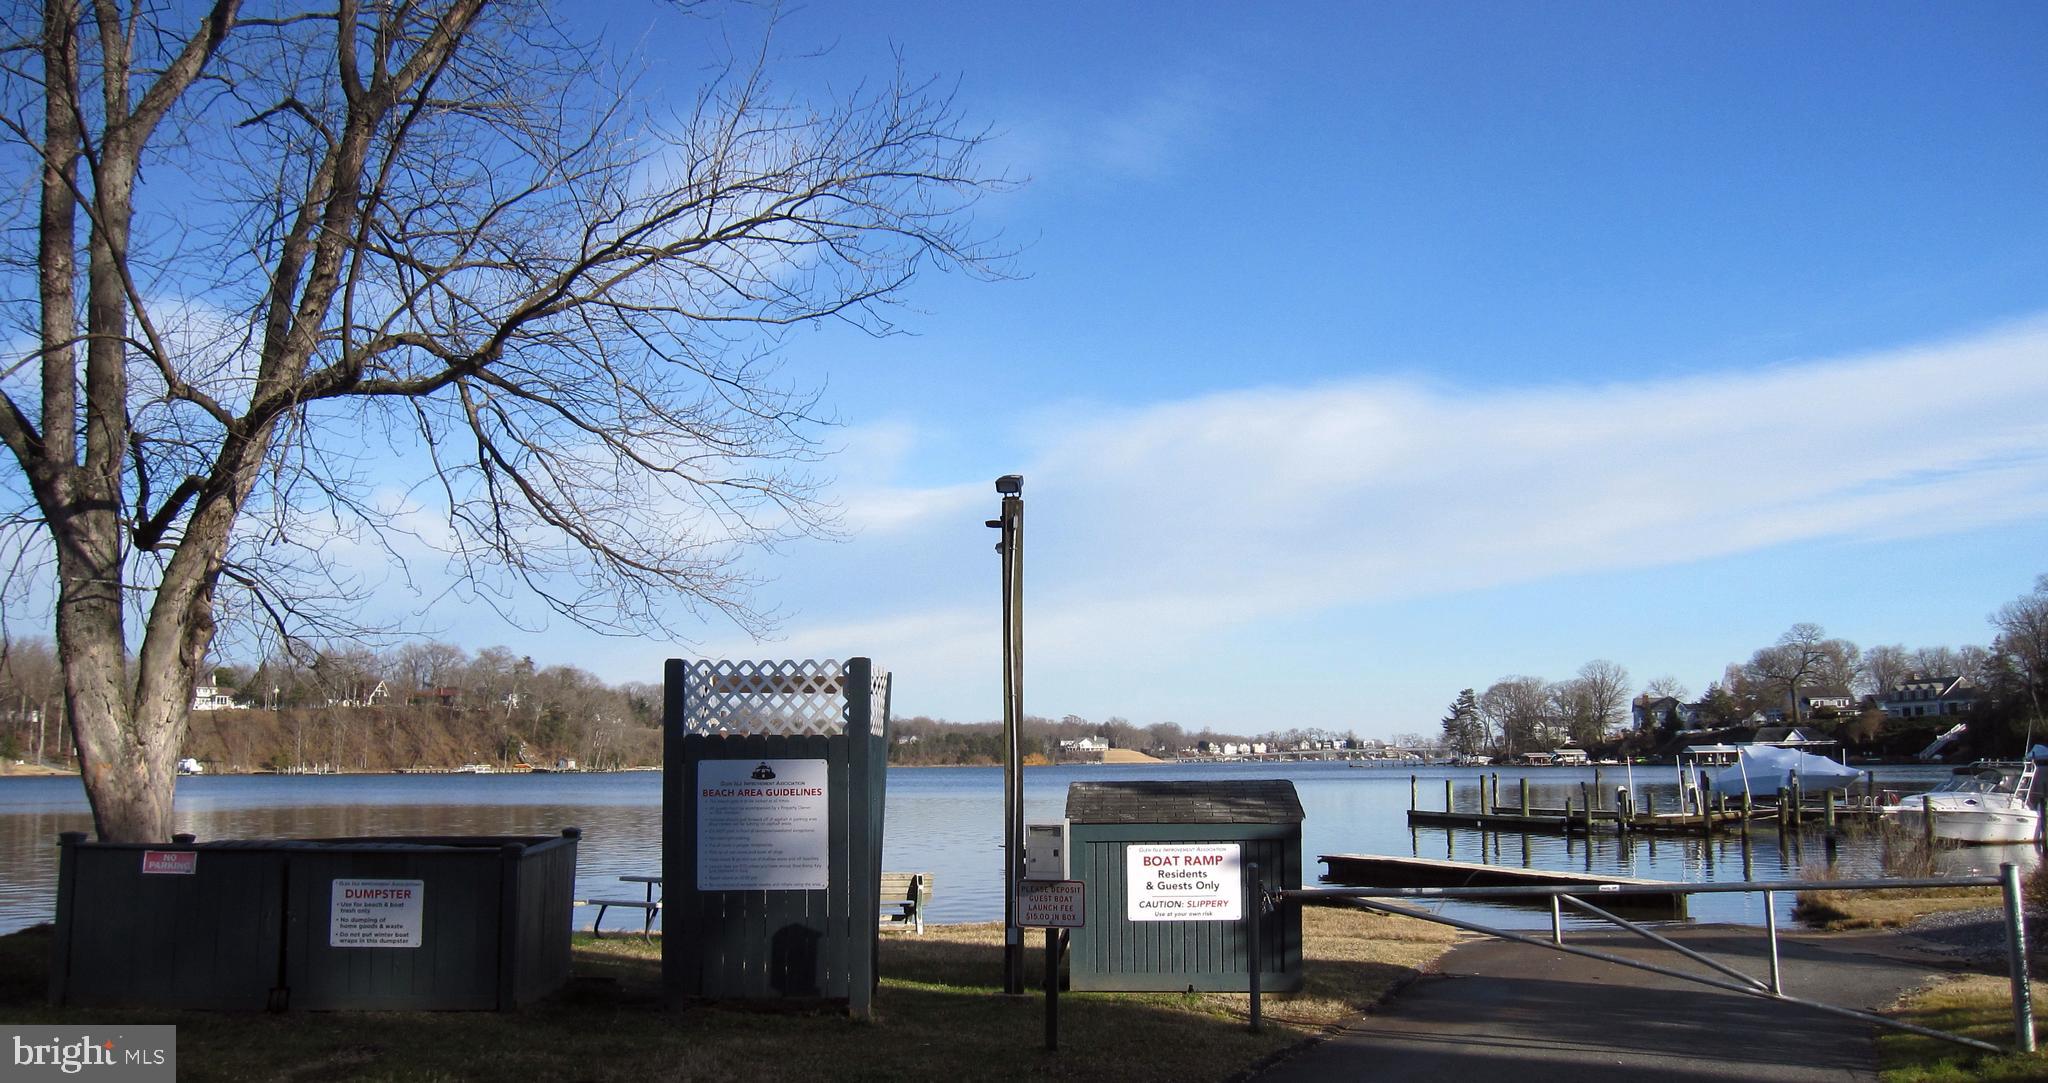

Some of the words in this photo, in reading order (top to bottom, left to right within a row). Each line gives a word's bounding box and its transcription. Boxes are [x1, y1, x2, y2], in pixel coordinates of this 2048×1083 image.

[703, 789, 734, 797] BEACH
[737, 788, 763, 797] AREA
[766, 788, 822, 797] GUIDELINES
[1143, 856, 1180, 866] BOAT
[1184, 855, 1223, 866] RAMP
[149, 861, 191, 870] PARKING
[1158, 869, 1207, 878] Residents
[1051, 886, 1080, 894] DEPOSIT
[1146, 881, 1154, 890] &
[1157, 881, 1193, 890] Guests
[1196, 880, 1220, 892] Only
[345, 889, 411, 899] DUMPSTER
[1139, 900, 1184, 908] CAUTION:
[1187, 900, 1229, 908] SLIPPERY
